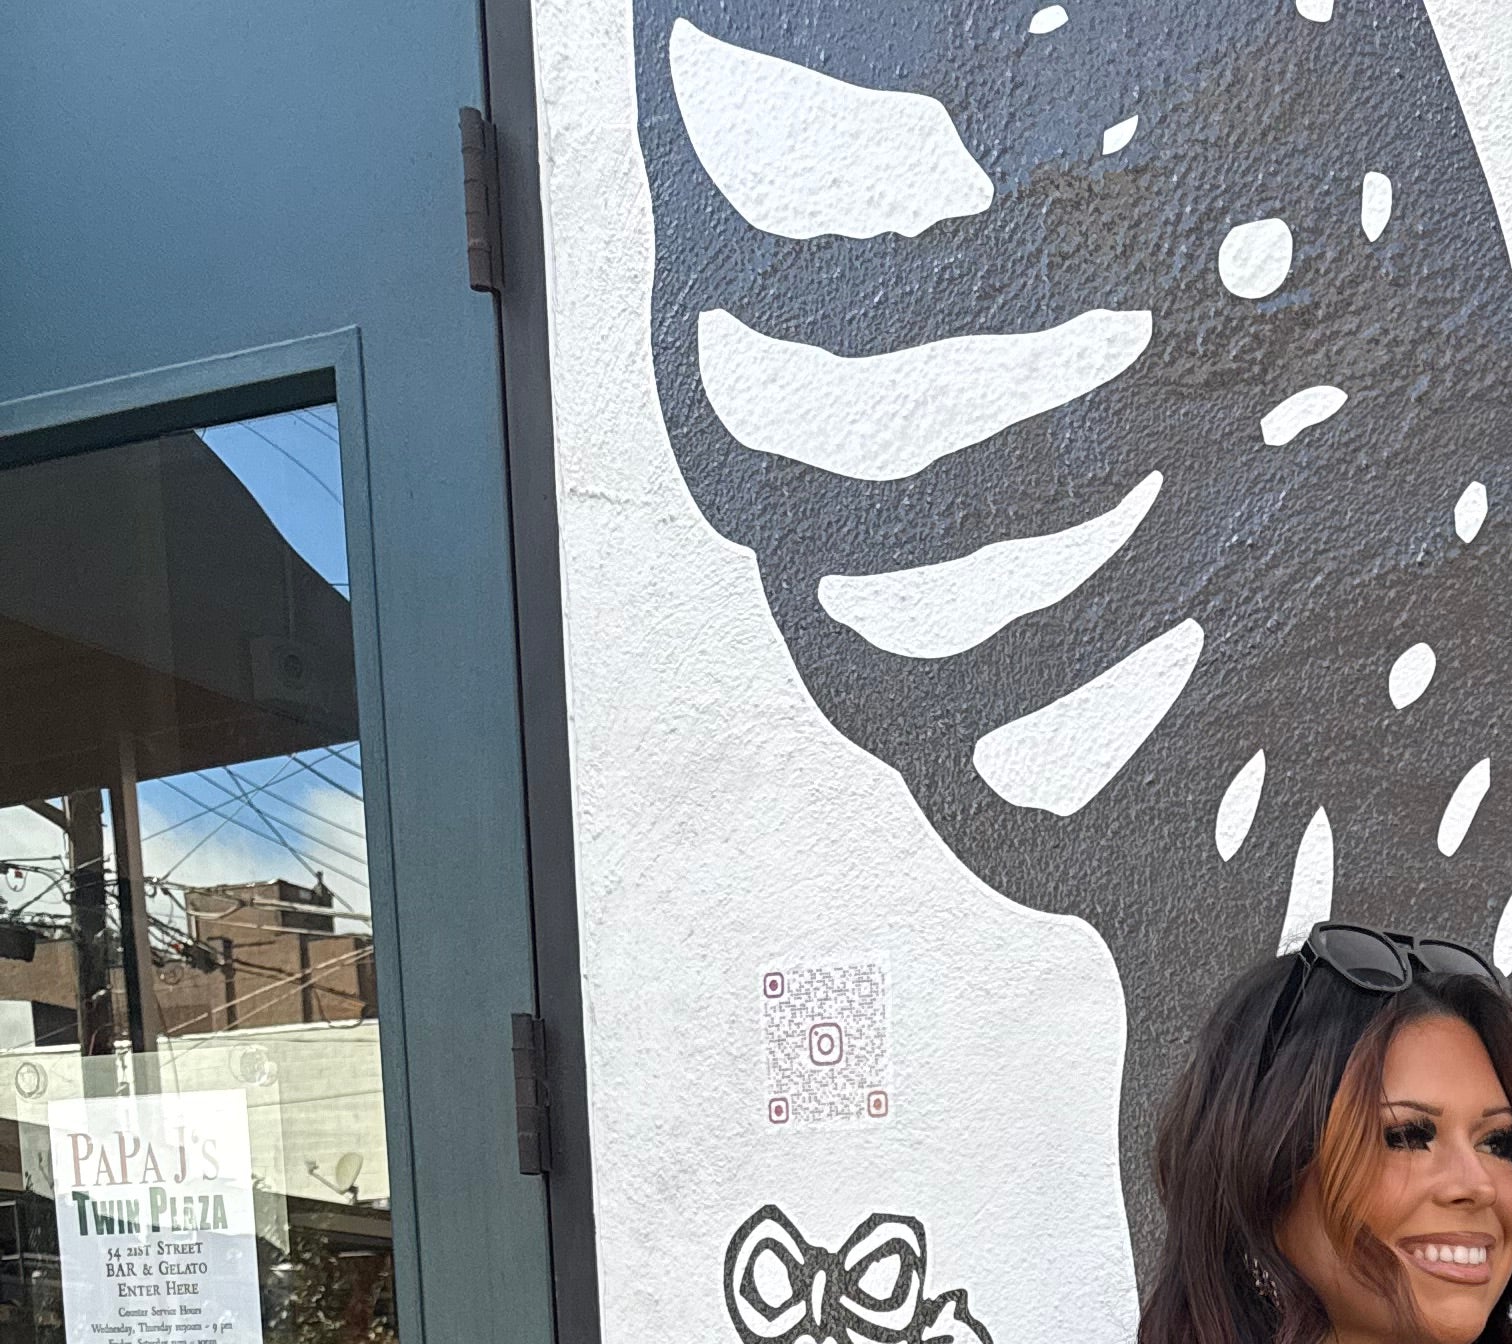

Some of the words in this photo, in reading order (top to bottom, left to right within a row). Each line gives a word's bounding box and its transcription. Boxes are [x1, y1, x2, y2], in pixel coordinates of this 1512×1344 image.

[71, 1190, 141, 1236] TWIN
[149, 1186, 229, 1233] PLAZA
[107, 1248, 122, 1261] 54
[157, 1240, 203, 1255] STREET
[106, 1262, 137, 1277] BAR
[143, 1263, 153, 1276] &
[159, 1260, 208, 1275] GELATO
[118, 1282, 161, 1297] ENTER
[166, 1280, 200, 1295] HERE
[179, 1305, 202, 1315] Hours
